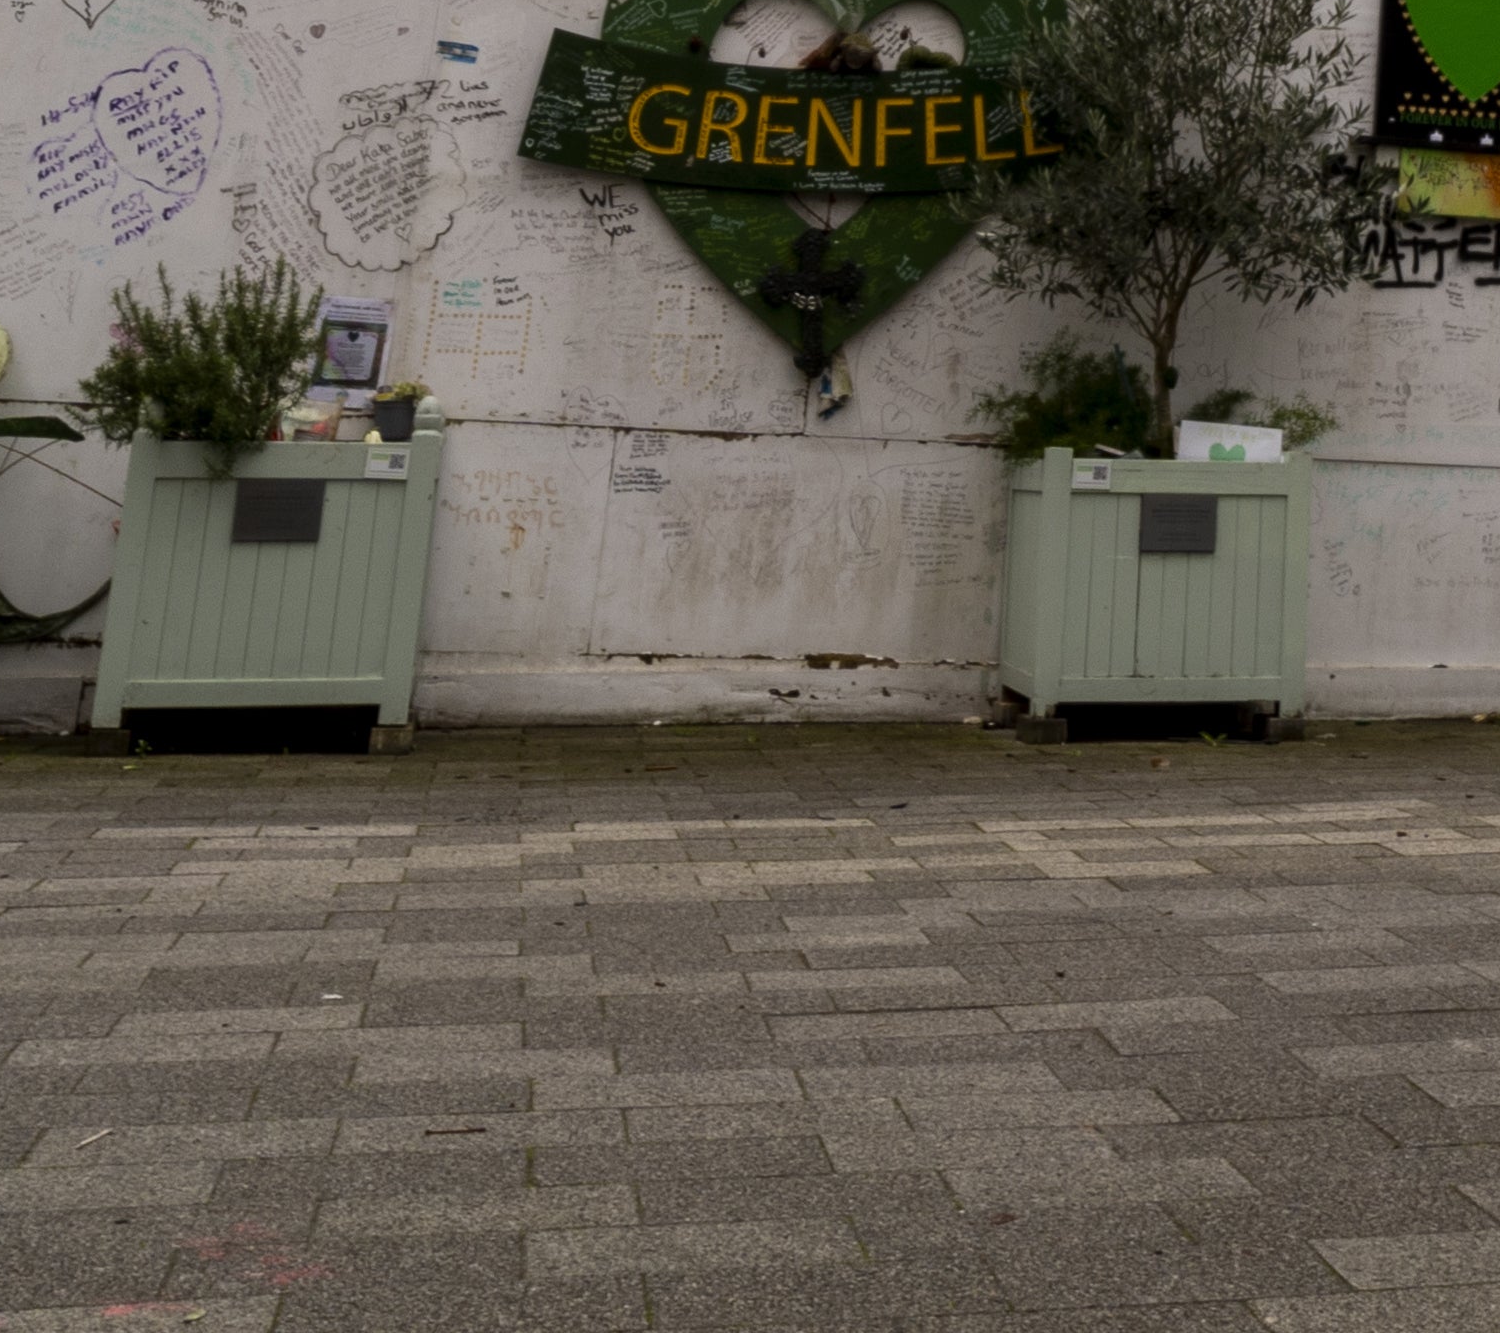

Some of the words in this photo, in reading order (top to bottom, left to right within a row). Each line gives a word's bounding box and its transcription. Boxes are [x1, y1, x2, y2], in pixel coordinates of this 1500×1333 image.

[627, 85, 1064, 168] GRENFELL
[1400, 112, 1451, 128] FOREVER
[1456, 117, 1468, 127] IN
[1472, 116, 1495, 130] OUR
[578, 182, 628, 209] WE
[598, 204, 639, 227] miss
[603, 223, 636, 247] you
